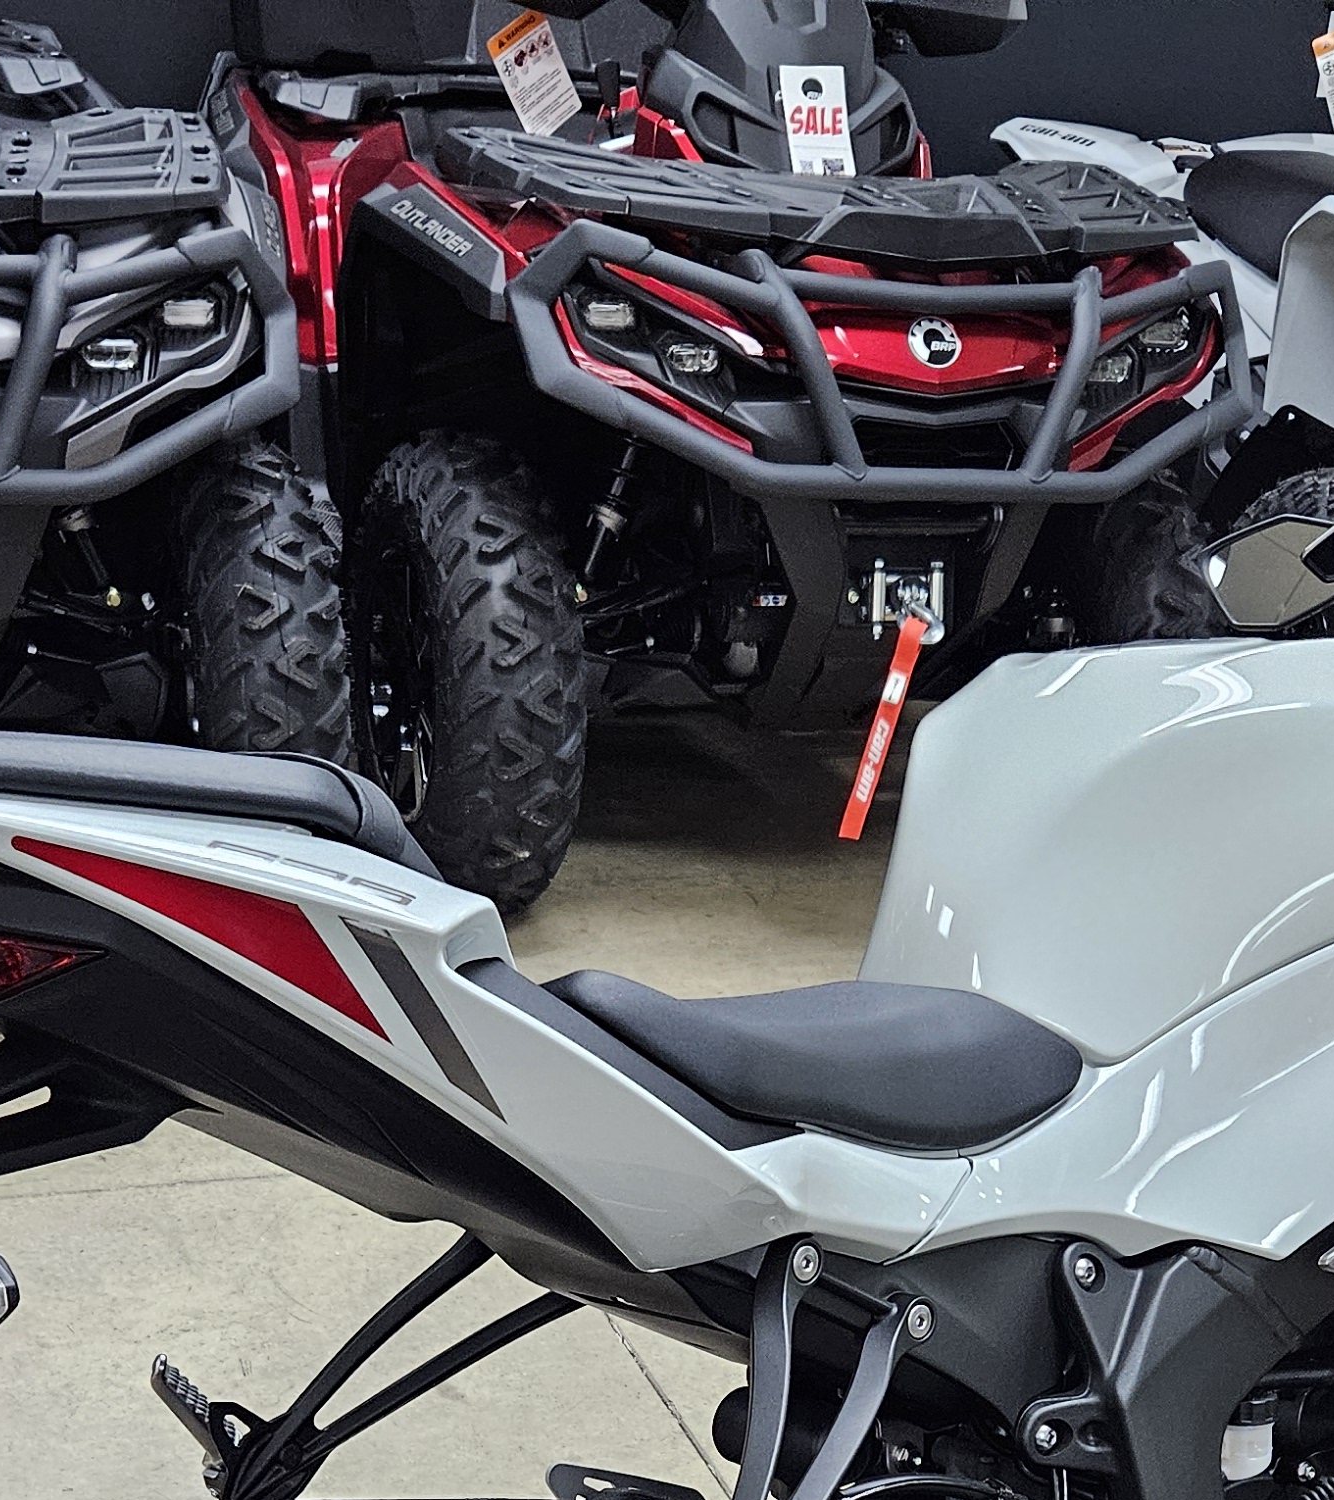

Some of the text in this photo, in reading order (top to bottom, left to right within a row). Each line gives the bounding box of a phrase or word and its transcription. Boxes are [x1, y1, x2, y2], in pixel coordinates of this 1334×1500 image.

[790, 105, 843, 136] SALE
[1019, 123, 1097, 148] can-am
[390, 199, 474, 258] OUTLANDER
[930, 340, 957, 352] BRP
